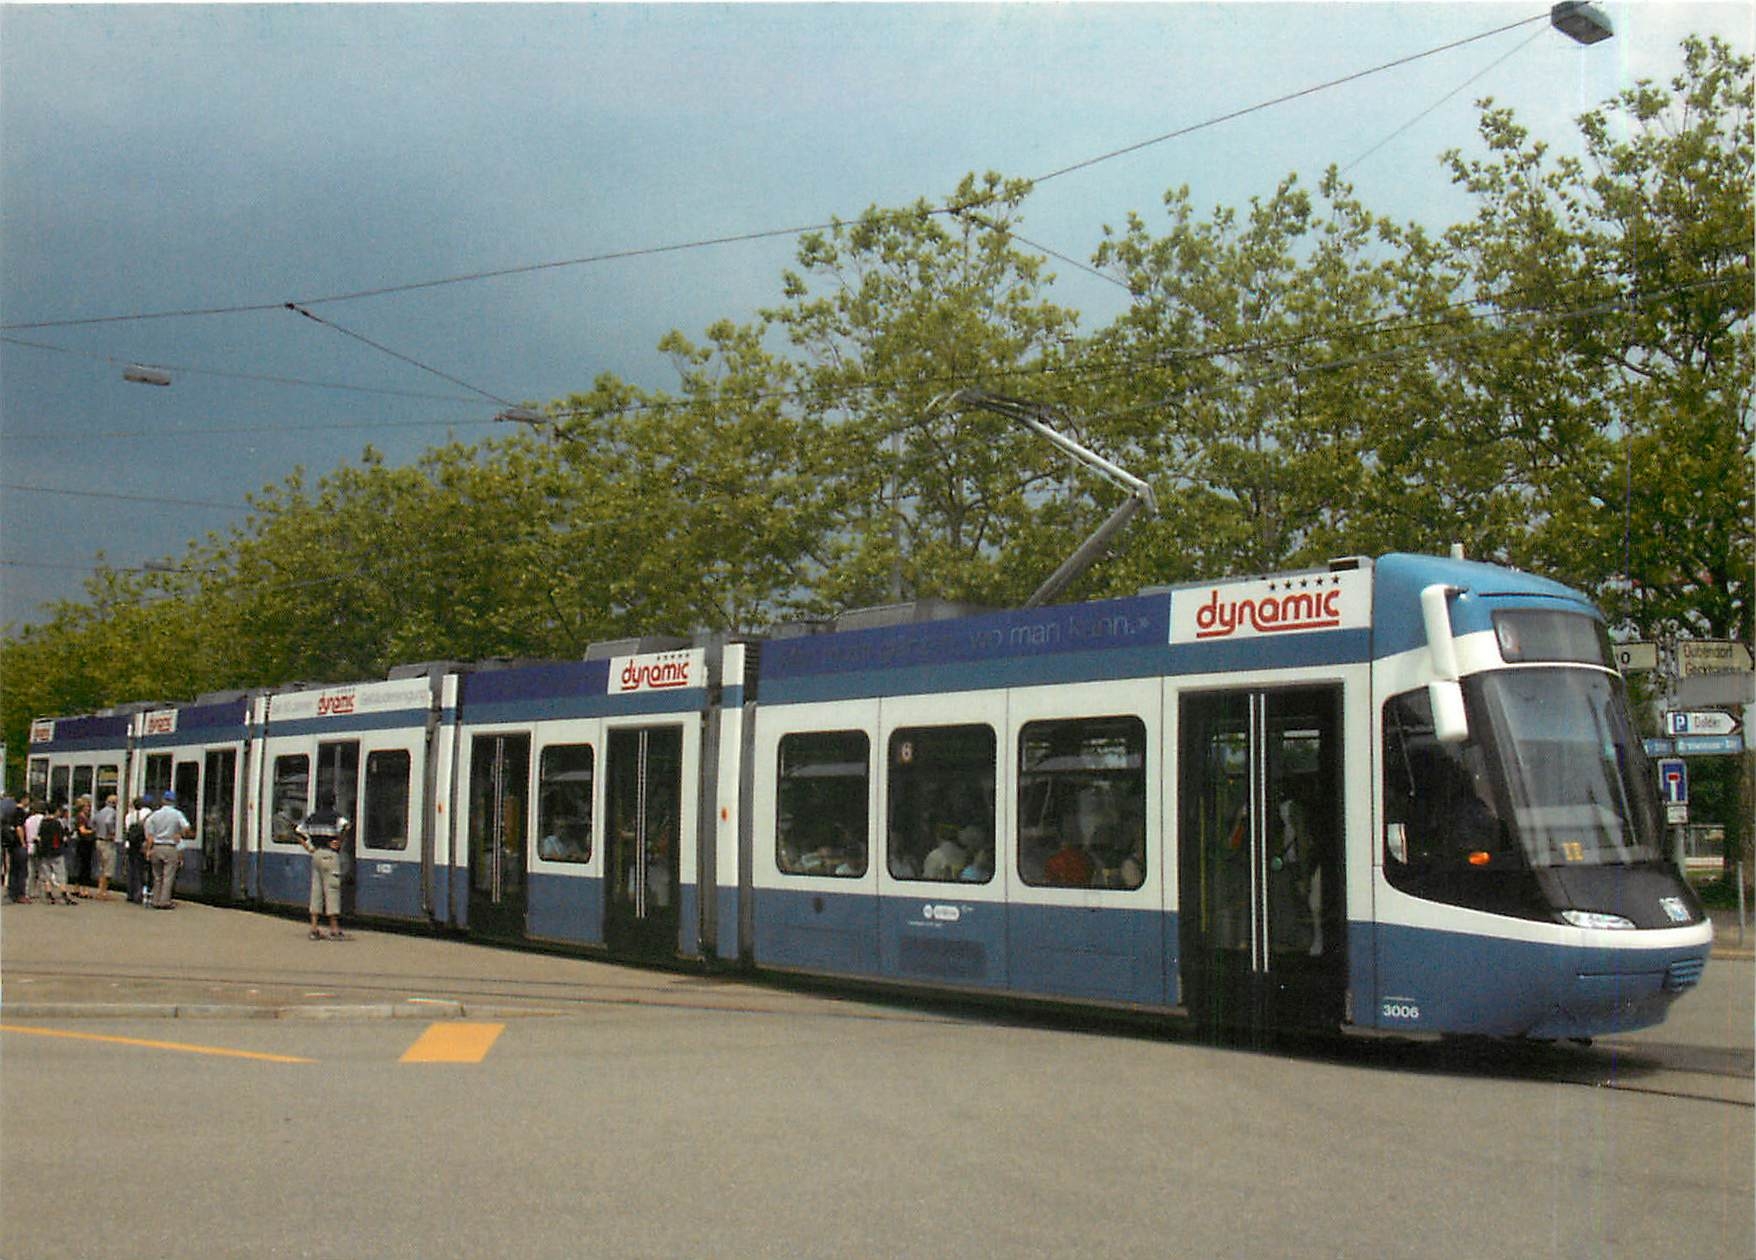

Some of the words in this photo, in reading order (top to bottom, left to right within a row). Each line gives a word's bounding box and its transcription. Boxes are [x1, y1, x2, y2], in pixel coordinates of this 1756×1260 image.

[1196, 589, 1341, 639] dynamic
[1010, 622, 1060, 646] man
[621, 658, 690, 691] dynamic
[1676, 714, 1686, 730] P
[1383, 1004, 1420, 1019] 3006
